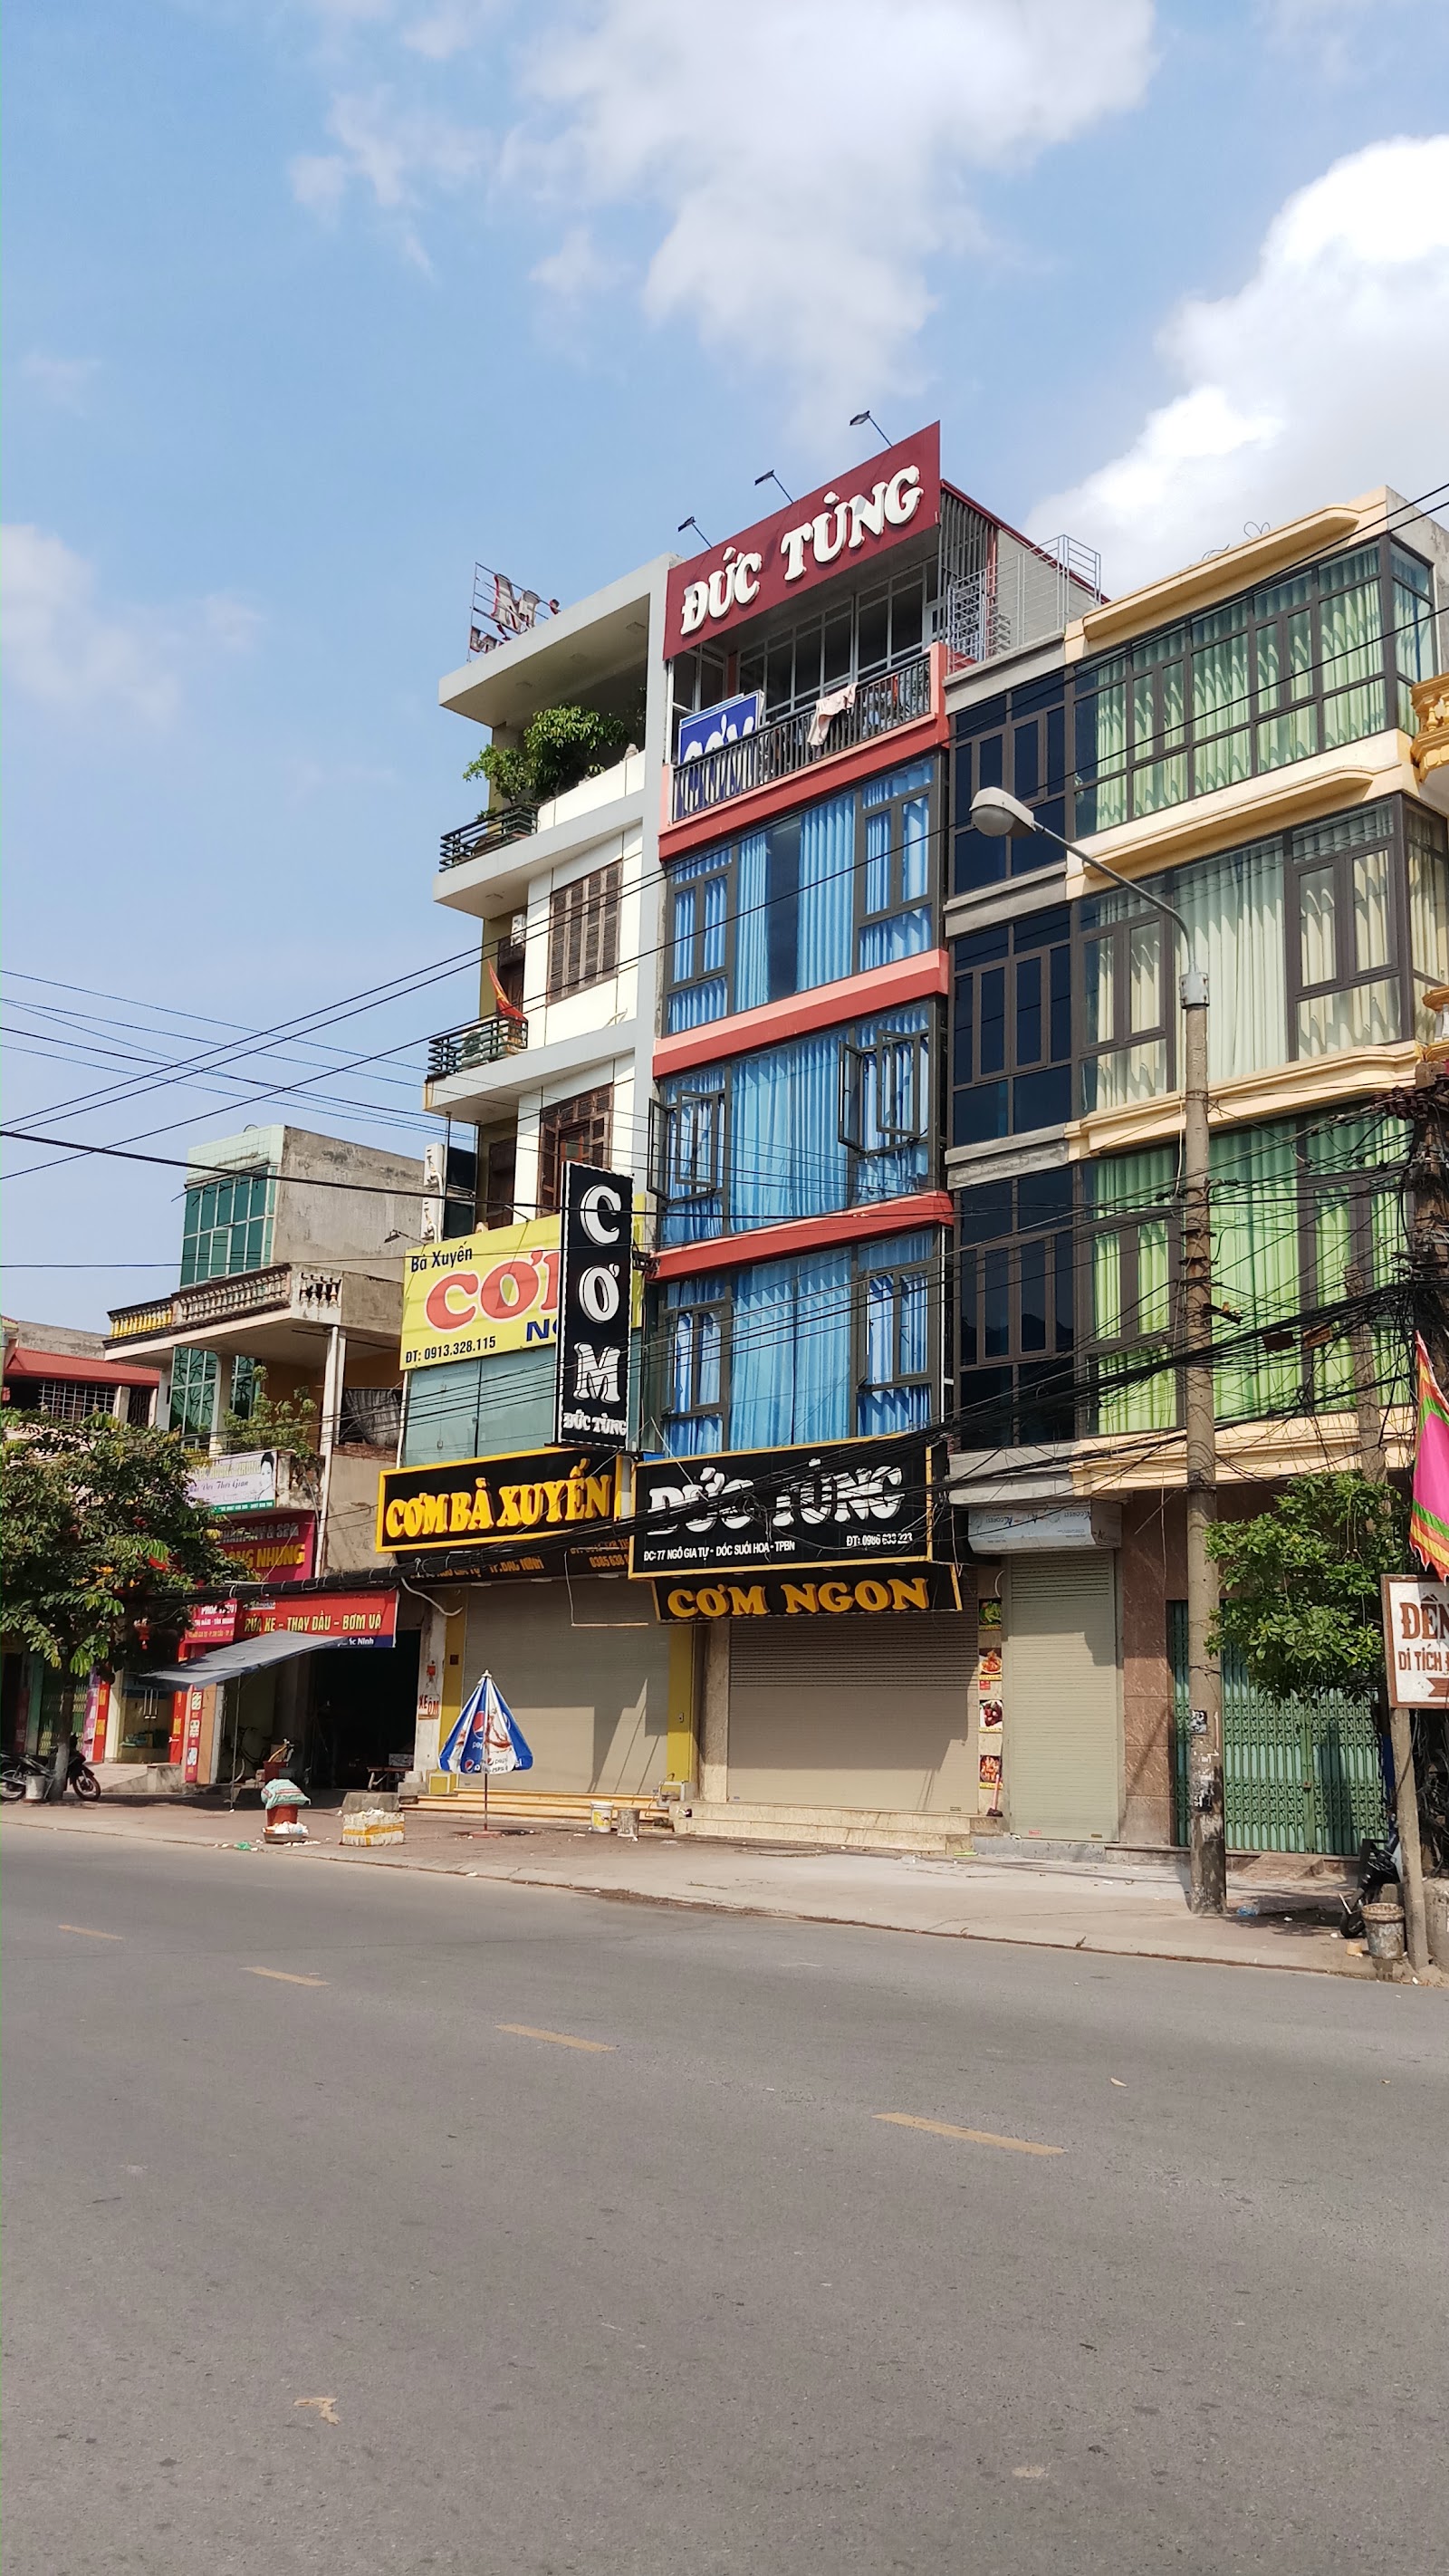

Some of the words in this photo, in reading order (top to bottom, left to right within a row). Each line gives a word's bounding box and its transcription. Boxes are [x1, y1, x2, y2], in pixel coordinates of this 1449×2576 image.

[681, 546, 763, 636] ĐỨC
[780, 465, 925, 582] TÙNG
[431, 1240, 473, 1268] Xuyến
[406, 1350, 422, 1364] ĐT:
[424, 1336, 496, 1360] 0913.328.115
[386, 1493, 449, 1537] CƠM
[496, 1458, 613, 1527] XUYẾN
[256, 1543, 305, 1568] NHUNG
[683, 1547, 697, 1559] GIA
[753, 1542, 770, 1554] HOA
[667, 1582, 770, 1619] CƠM
[781, 1577, 930, 1615] NGON
[264, 1617, 277, 1632] XE
[286, 1615, 311, 1631] THAY
[312, 1610, 331, 1631] DẦU
[341, 1612, 367, 1631] BƠM
[1414, 1643, 1443, 1671] TÍCH
